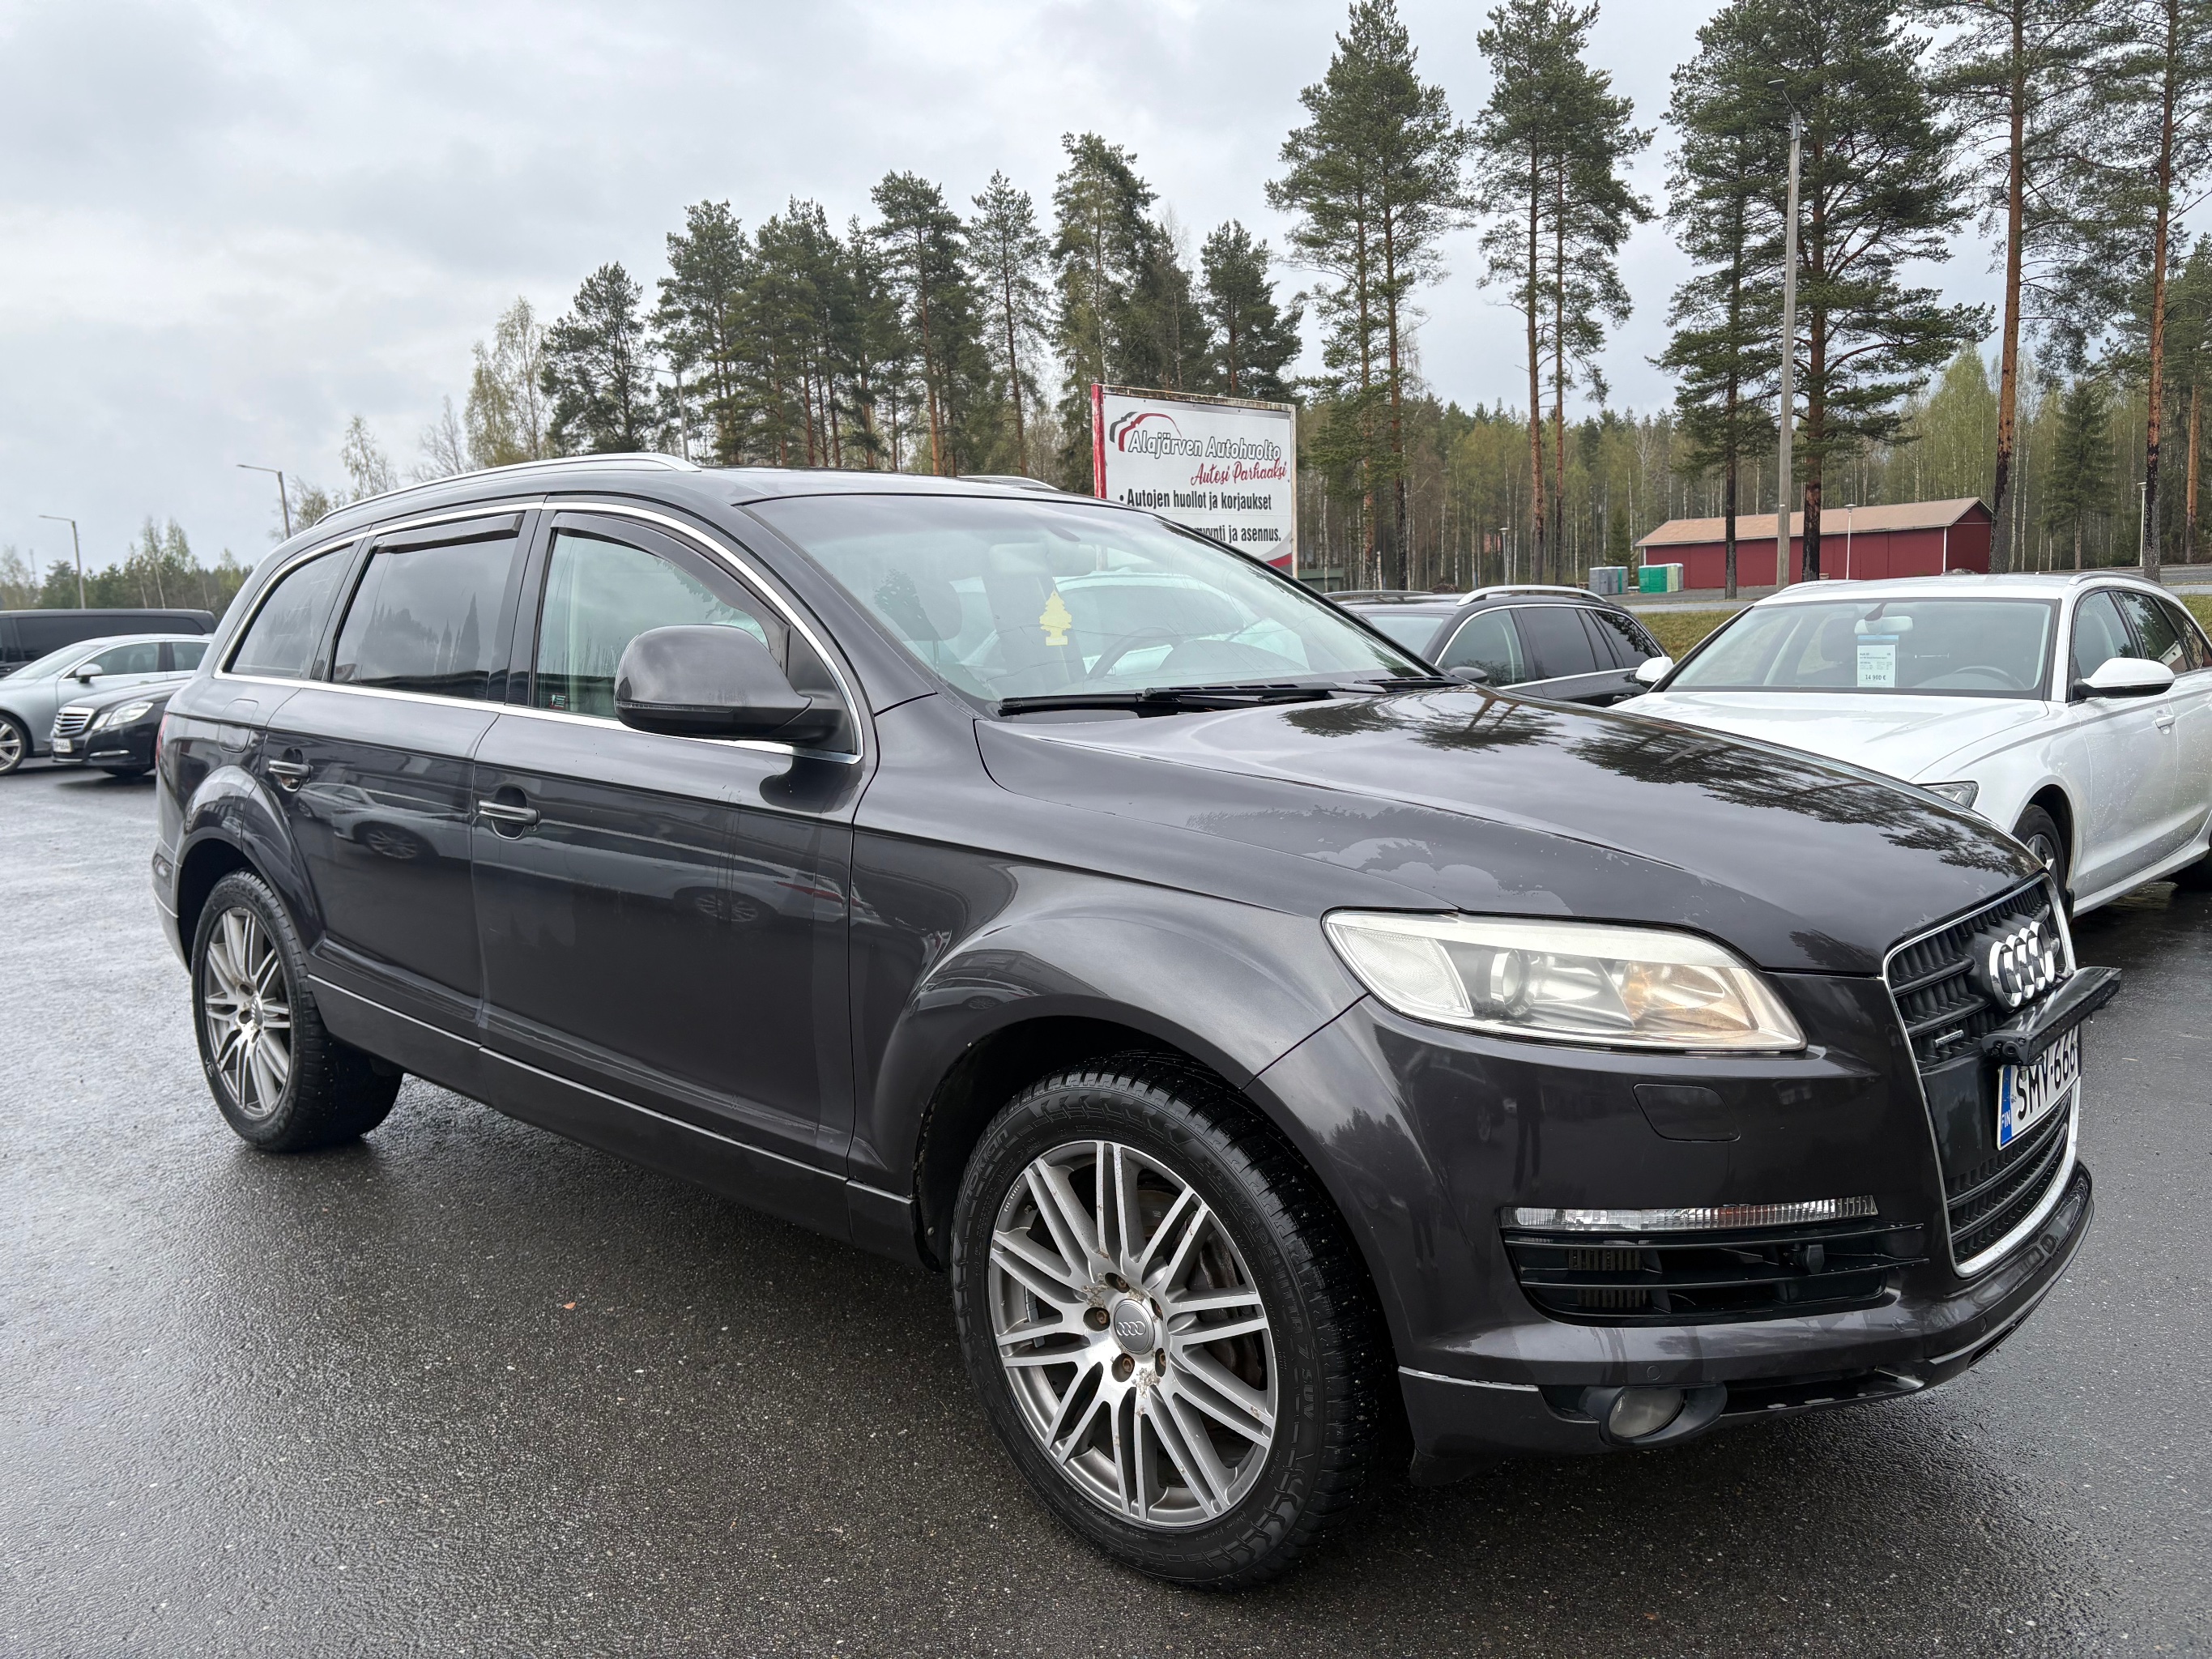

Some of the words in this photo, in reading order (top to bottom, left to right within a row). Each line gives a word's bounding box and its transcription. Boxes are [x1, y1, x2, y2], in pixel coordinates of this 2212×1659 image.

[1128, 430, 1203, 459] Alajärven
[1205, 437, 1281, 462] Autohuolto
[1191, 463, 1230, 486] Autosi
[1232, 458, 1287, 484] Parhaaksi
[1127, 488, 1170, 510] Autojen
[1174, 490, 1207, 509] huollot
[1209, 493, 1217, 511] ja
[1221, 493, 1272, 511] korjaukset
[1228, 524, 1238, 544] ja
[1241, 527, 1281, 542] asennus.
[2001, 1109, 2011, 1129] FIN
[1301, 1367, 1315, 1421] SUV
